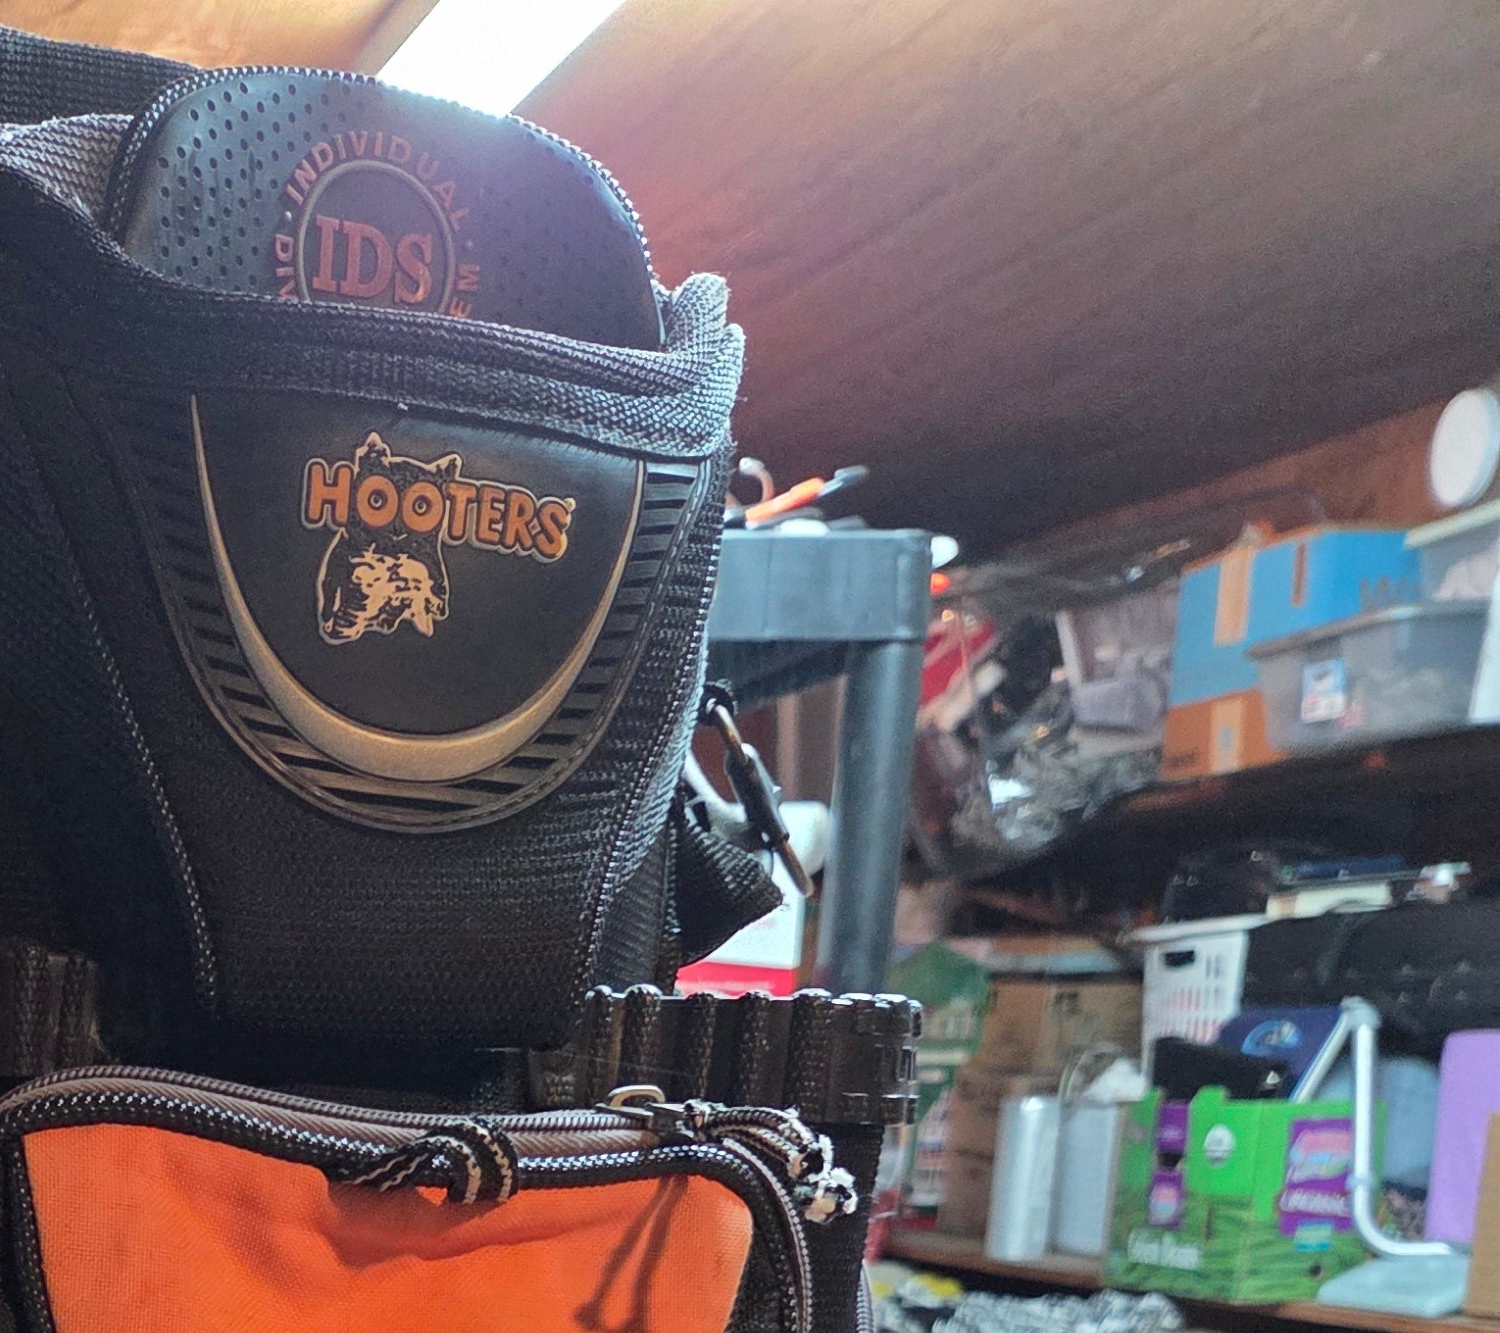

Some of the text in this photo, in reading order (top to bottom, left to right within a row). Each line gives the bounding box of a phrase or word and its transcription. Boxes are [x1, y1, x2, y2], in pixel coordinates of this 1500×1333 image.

[286, 130, 470, 231] INDIVIDUAL
[312, 214, 433, 304] IDS
[301, 458, 572, 563] HOOTERS
